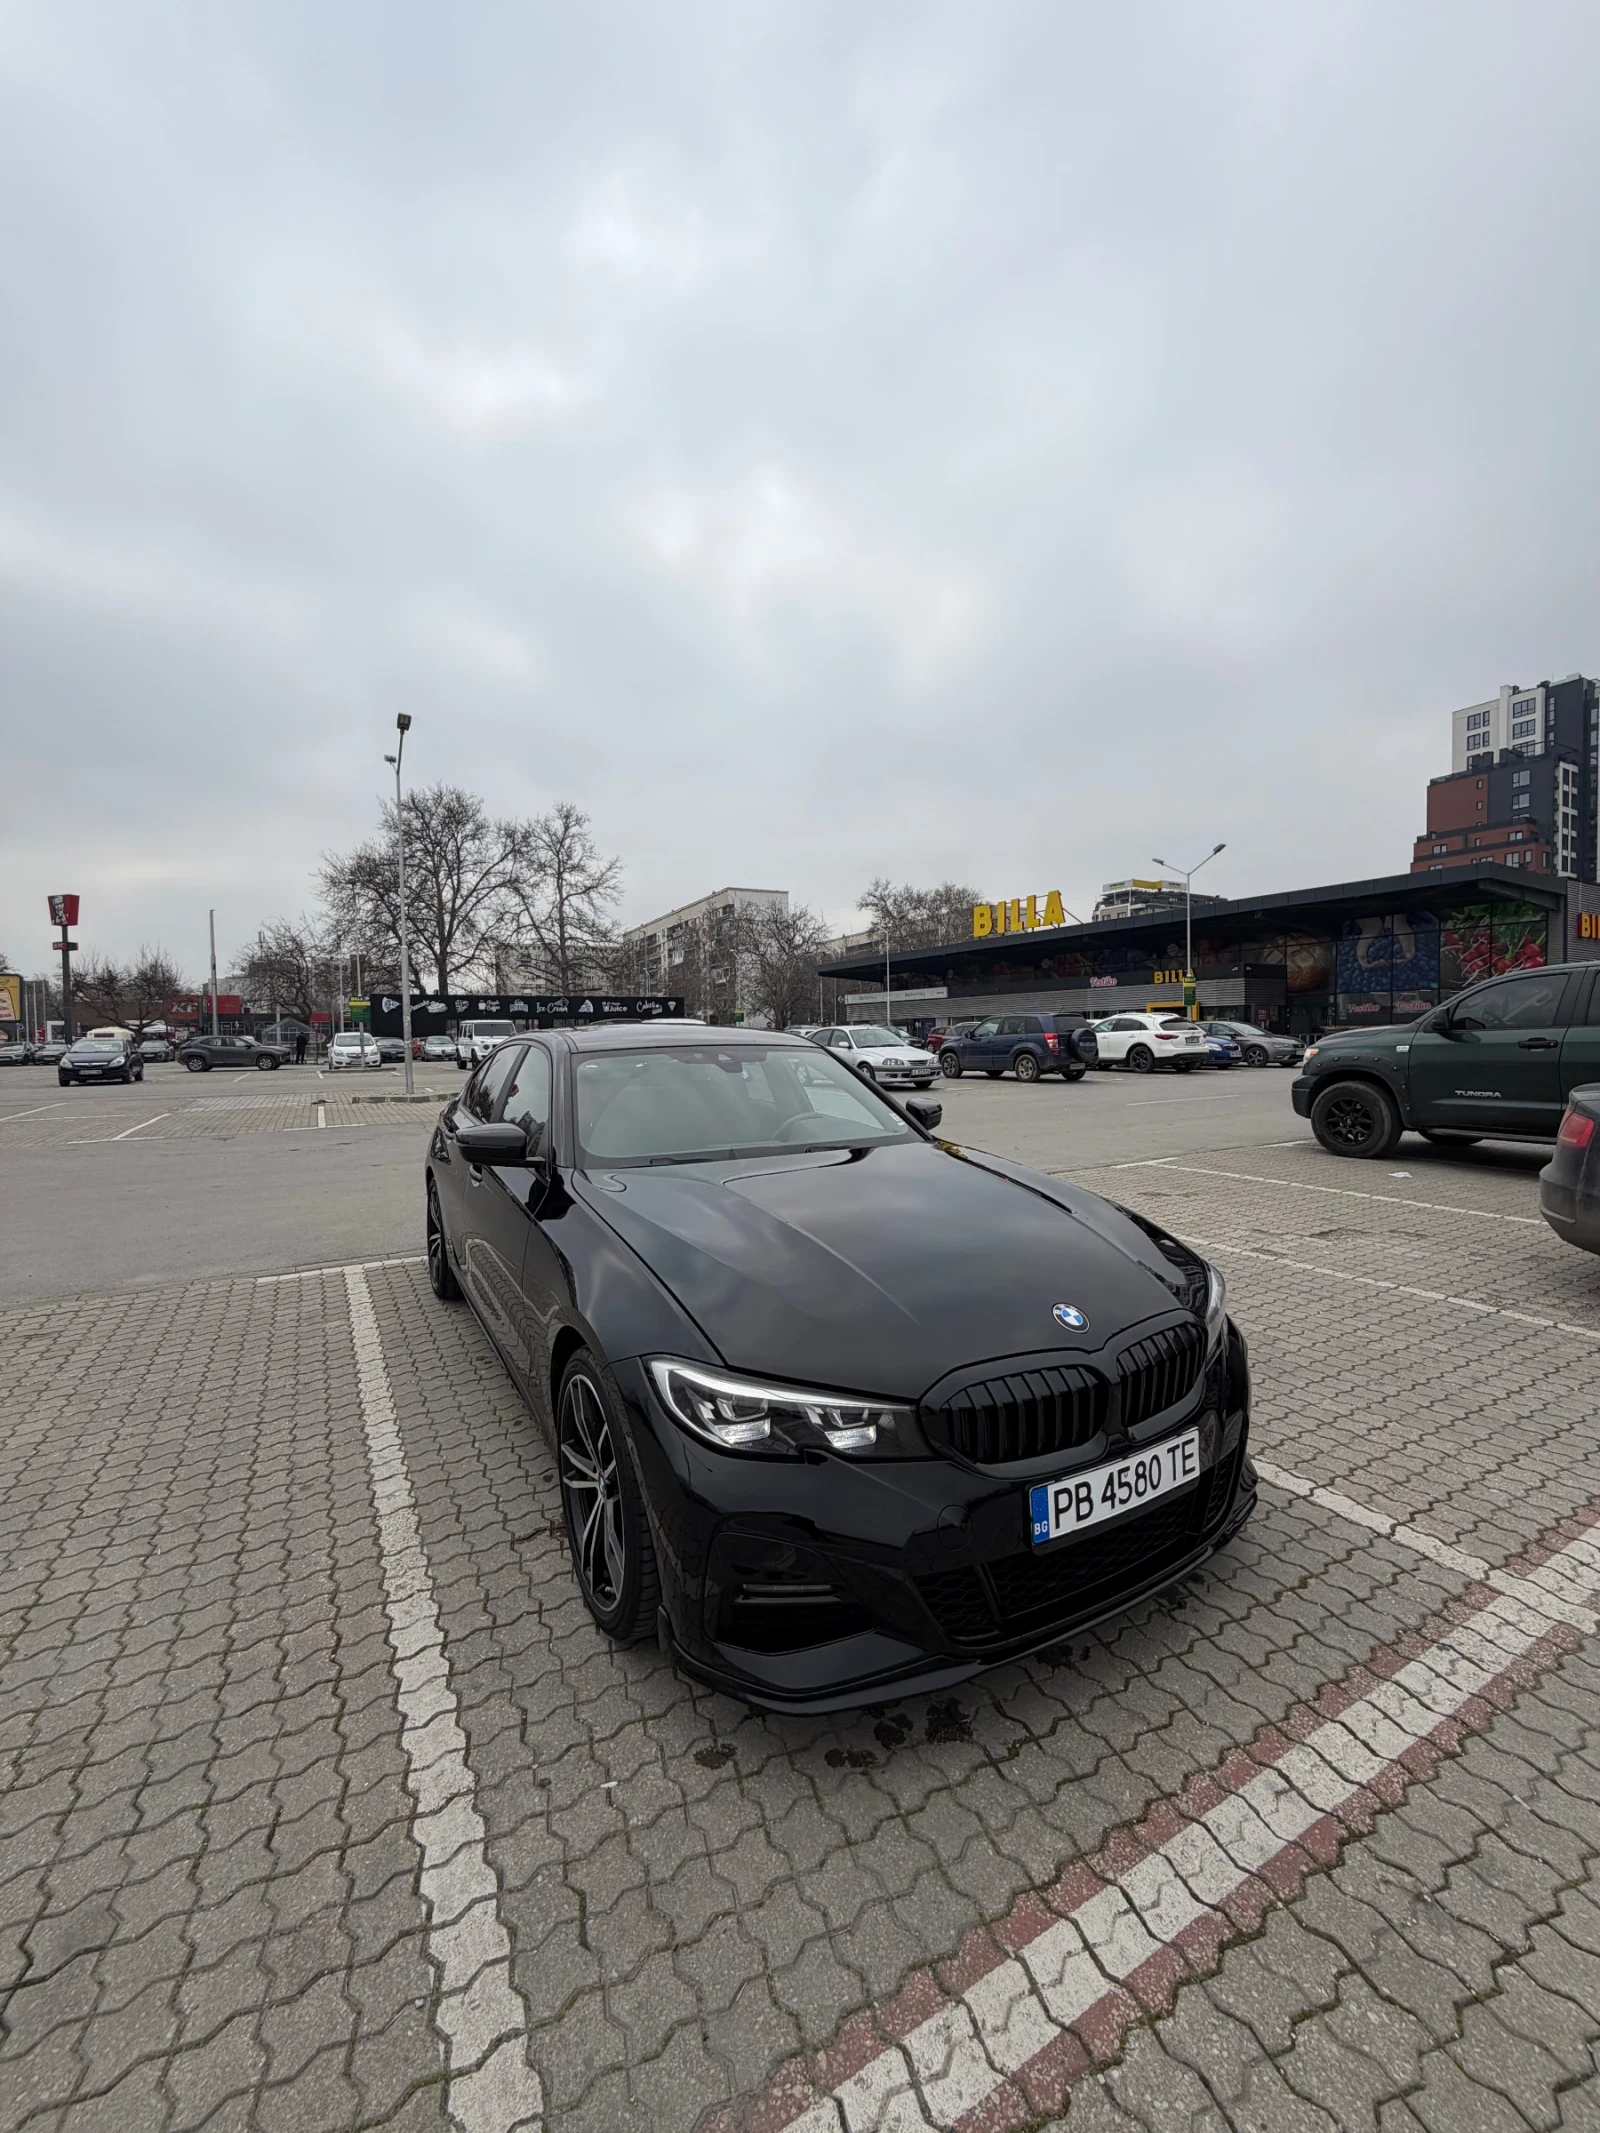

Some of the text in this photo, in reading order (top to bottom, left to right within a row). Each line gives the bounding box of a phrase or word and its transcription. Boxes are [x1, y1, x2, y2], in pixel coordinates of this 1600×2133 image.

[973, 890, 1066, 937] BILLA
[1580, 913, 1600, 938] BI
[170, 1002, 199, 1013] KF
[536, 1001, 546, 1013] Ice
[547, 1001, 569, 1013] Cream
[608, 1004, 628, 1012] Juice
[1455, 1090, 1502, 1098] TUNDRA
[1053, 1437, 1196, 1530] PB 4580 TE
[1034, 1520, 1048, 1536] BG
